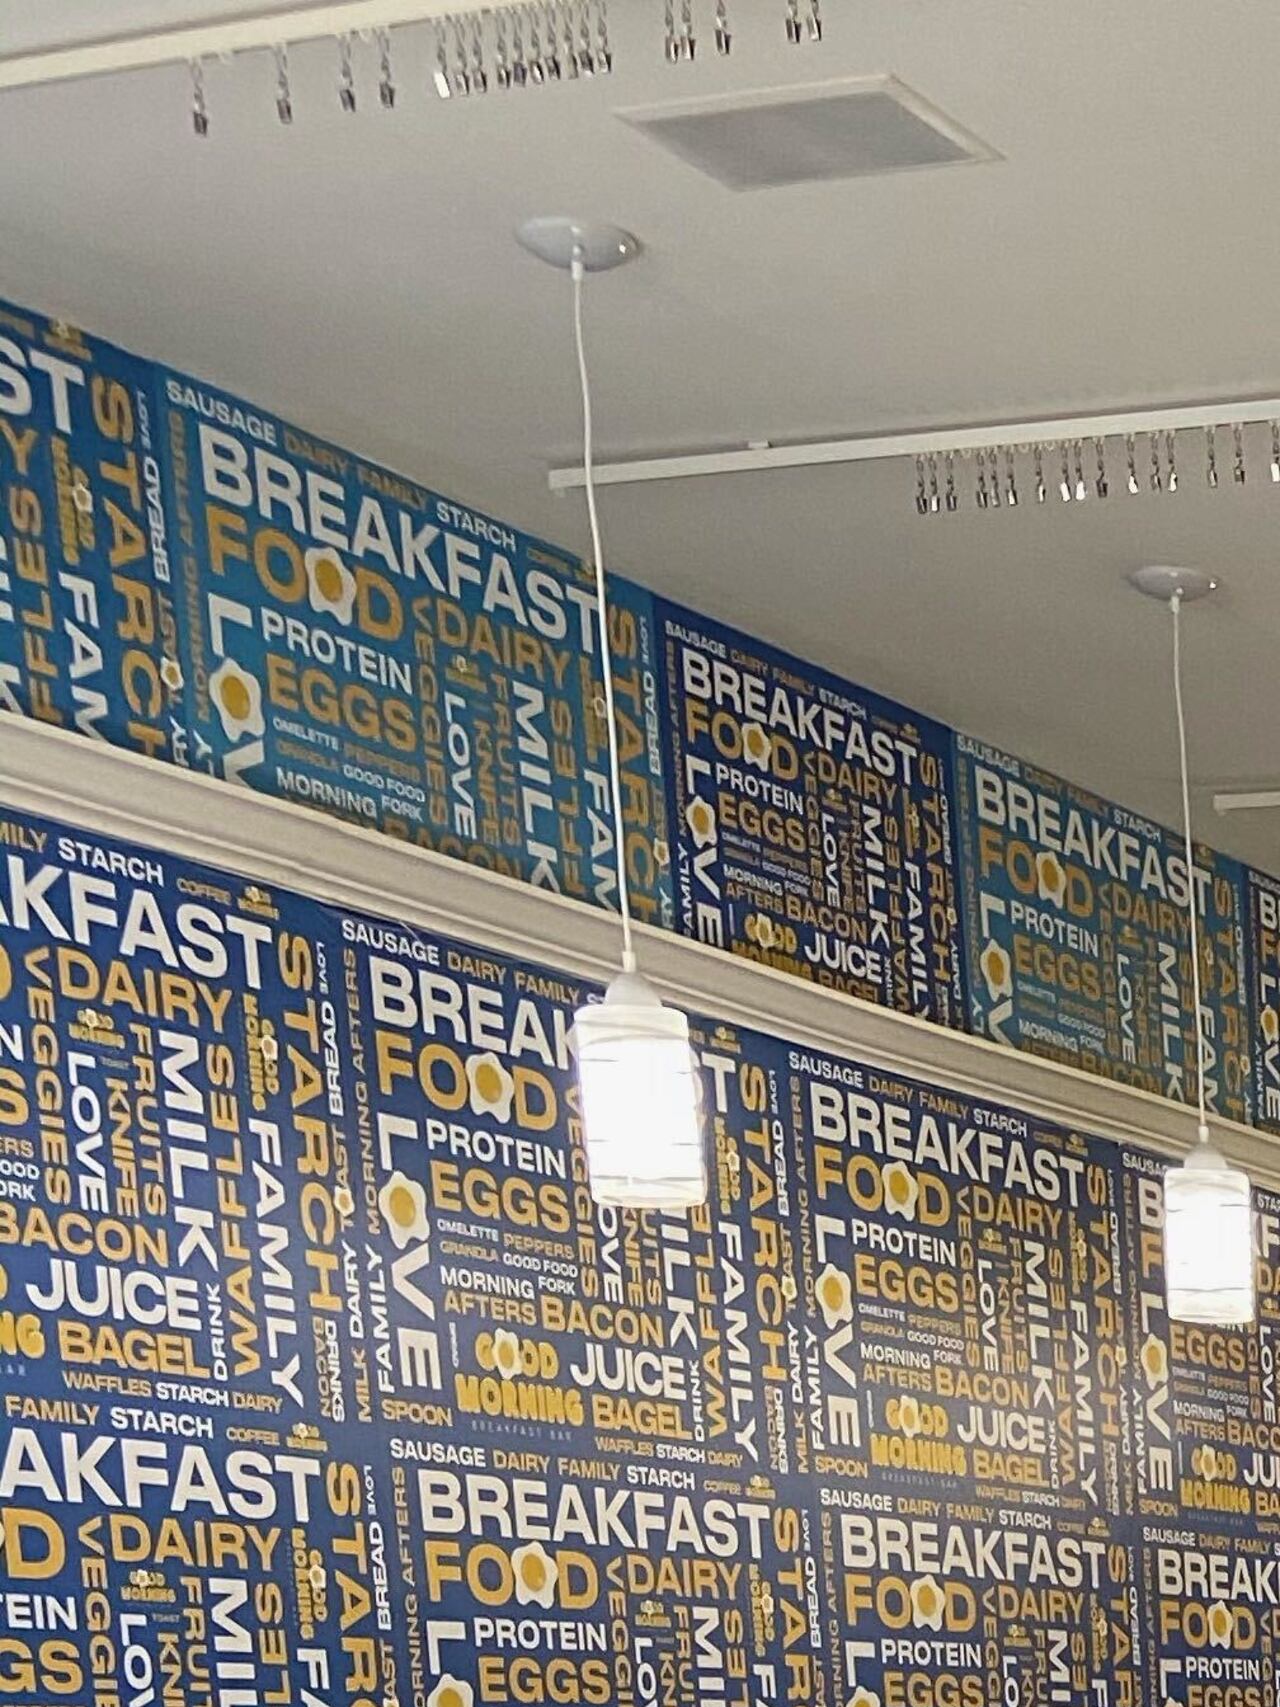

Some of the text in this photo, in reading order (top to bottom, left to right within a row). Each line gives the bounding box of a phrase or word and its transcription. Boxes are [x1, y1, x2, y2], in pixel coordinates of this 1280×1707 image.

[197, 422, 607, 661] BREAKFAST
[260, 606, 414, 697] PROTEIN
[265, 650, 419, 757] EGGS
[681, 645, 919, 789] BREAKFAST
[715, 761, 804, 817] PROTEIN
[58, 834, 162, 887] STARCH
[974, 763, 1214, 921] BREAKFAST
[339, 916, 440, 966] SAUSAGE
[802, 927, 882, 985] JUICE
[1010, 899, 1099, 959] PROTEIN
[57, 944, 233, 1038] DAIRY
[788, 1047, 1026, 1139] SAUSAGE STARCH
[156, 1029, 216, 1272] MILK
[426, 1118, 567, 1181] PROTEIN
[810, 1079, 1086, 1212] BREAKFAST
[431, 1159, 571, 1236] EGGS
[972, 1184, 1063, 1243] DAIRY
[852, 1218, 956, 1268] PROTEIN
[25, 1253, 201, 1332] JUICE
[855, 1252, 959, 1315] EGGS
[61, 1320, 209, 1380] BAGEL
[540, 1294, 665, 1349] BACON
[1169, 1323, 1247, 1374] EGGS
[566, 1338, 687, 1401] JUICE
[861, 1342, 931, 1371] MORNING
[935, 1365, 1029, 1410] BACON
[590, 1393, 693, 1441] BAGEL
[954, 1402, 1045, 1454] JUICE
[389, 1437, 695, 1491] SAUSAGE DAIRY FAMILY STARCH
[417, 1468, 773, 1560] BREAKFAST
[820, 1484, 1050, 1531] SAUSAGE DAIRY FAMILY STARCH
[1142, 1525, 1195, 1546] SAUSAGE
[109, 1513, 282, 1573] DAIRY
[841, 1510, 1108, 1591] BREAKFAST
[626, 1553, 743, 1601] DAIRY
[997, 1584, 1085, 1626] DAIRY
[473, 1617, 608, 1652] PROTEIN
[881, 1638, 982, 1668] PROTEIN
[477, 1656, 612, 1705] EGGS
[1185, 1656, 1260, 1681] PROTEIN
